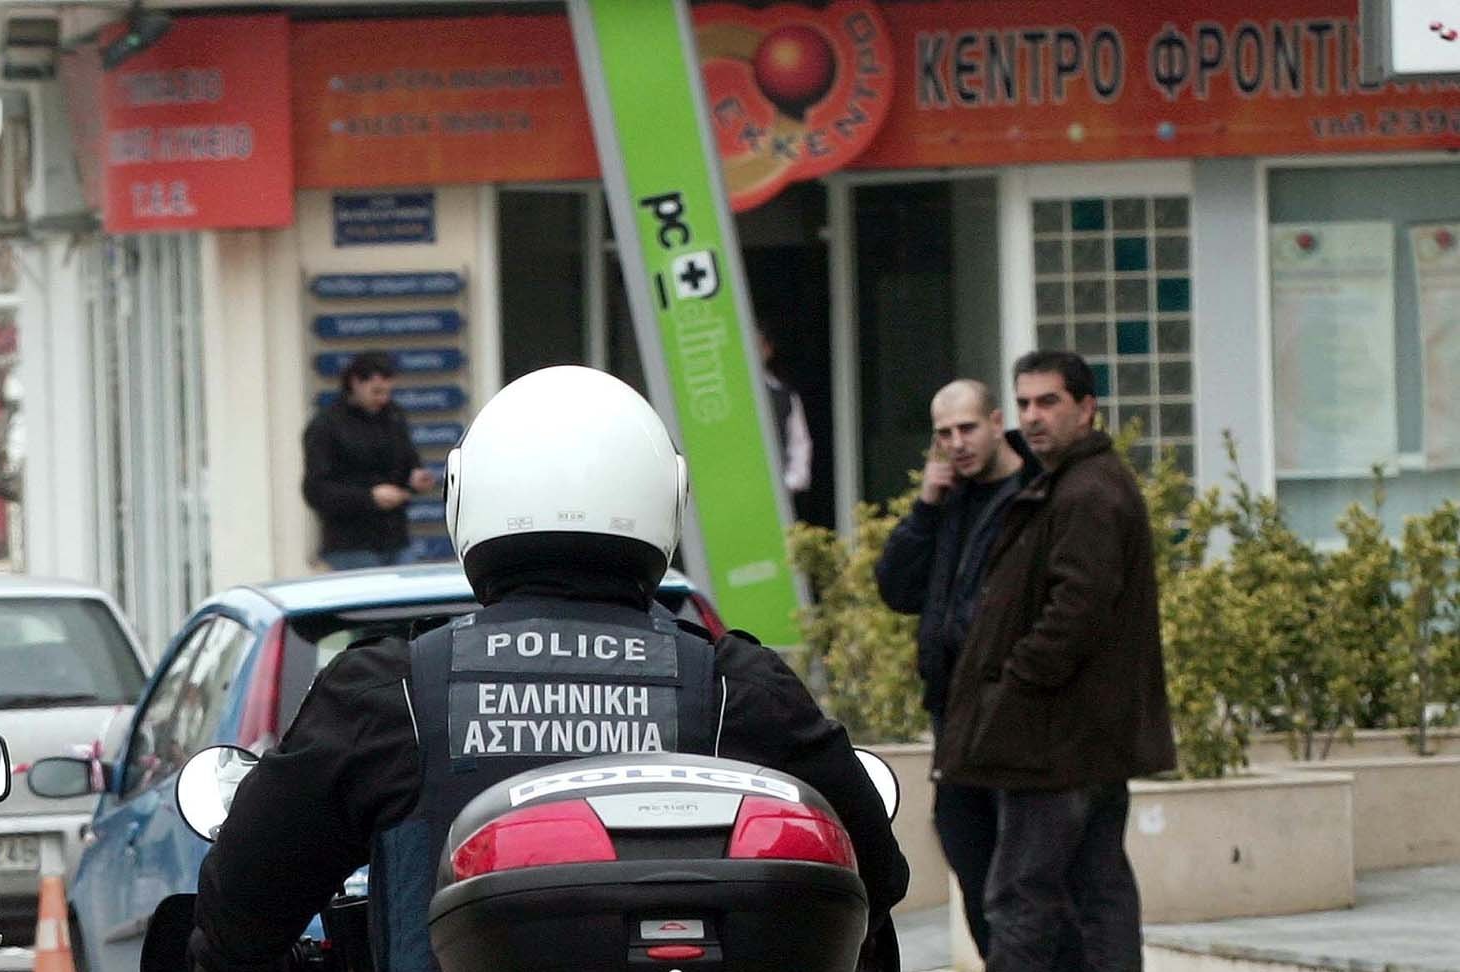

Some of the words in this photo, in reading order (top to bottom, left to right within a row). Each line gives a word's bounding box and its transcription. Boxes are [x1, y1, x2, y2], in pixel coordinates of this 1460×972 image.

[916, 26, 1124, 110] ΚΕΝΤΡΟ
[1149, 20, 1386, 99] ΦΡΟΝΤΙ
[487, 631, 648, 662] POLICE
[477, 683, 650, 716] ΕΛΛΗΝΙΚΗ
[462, 719, 663, 754] ΑΣΤΥΝΟΜΙΑ
[519, 768, 792, 798] POLICE
